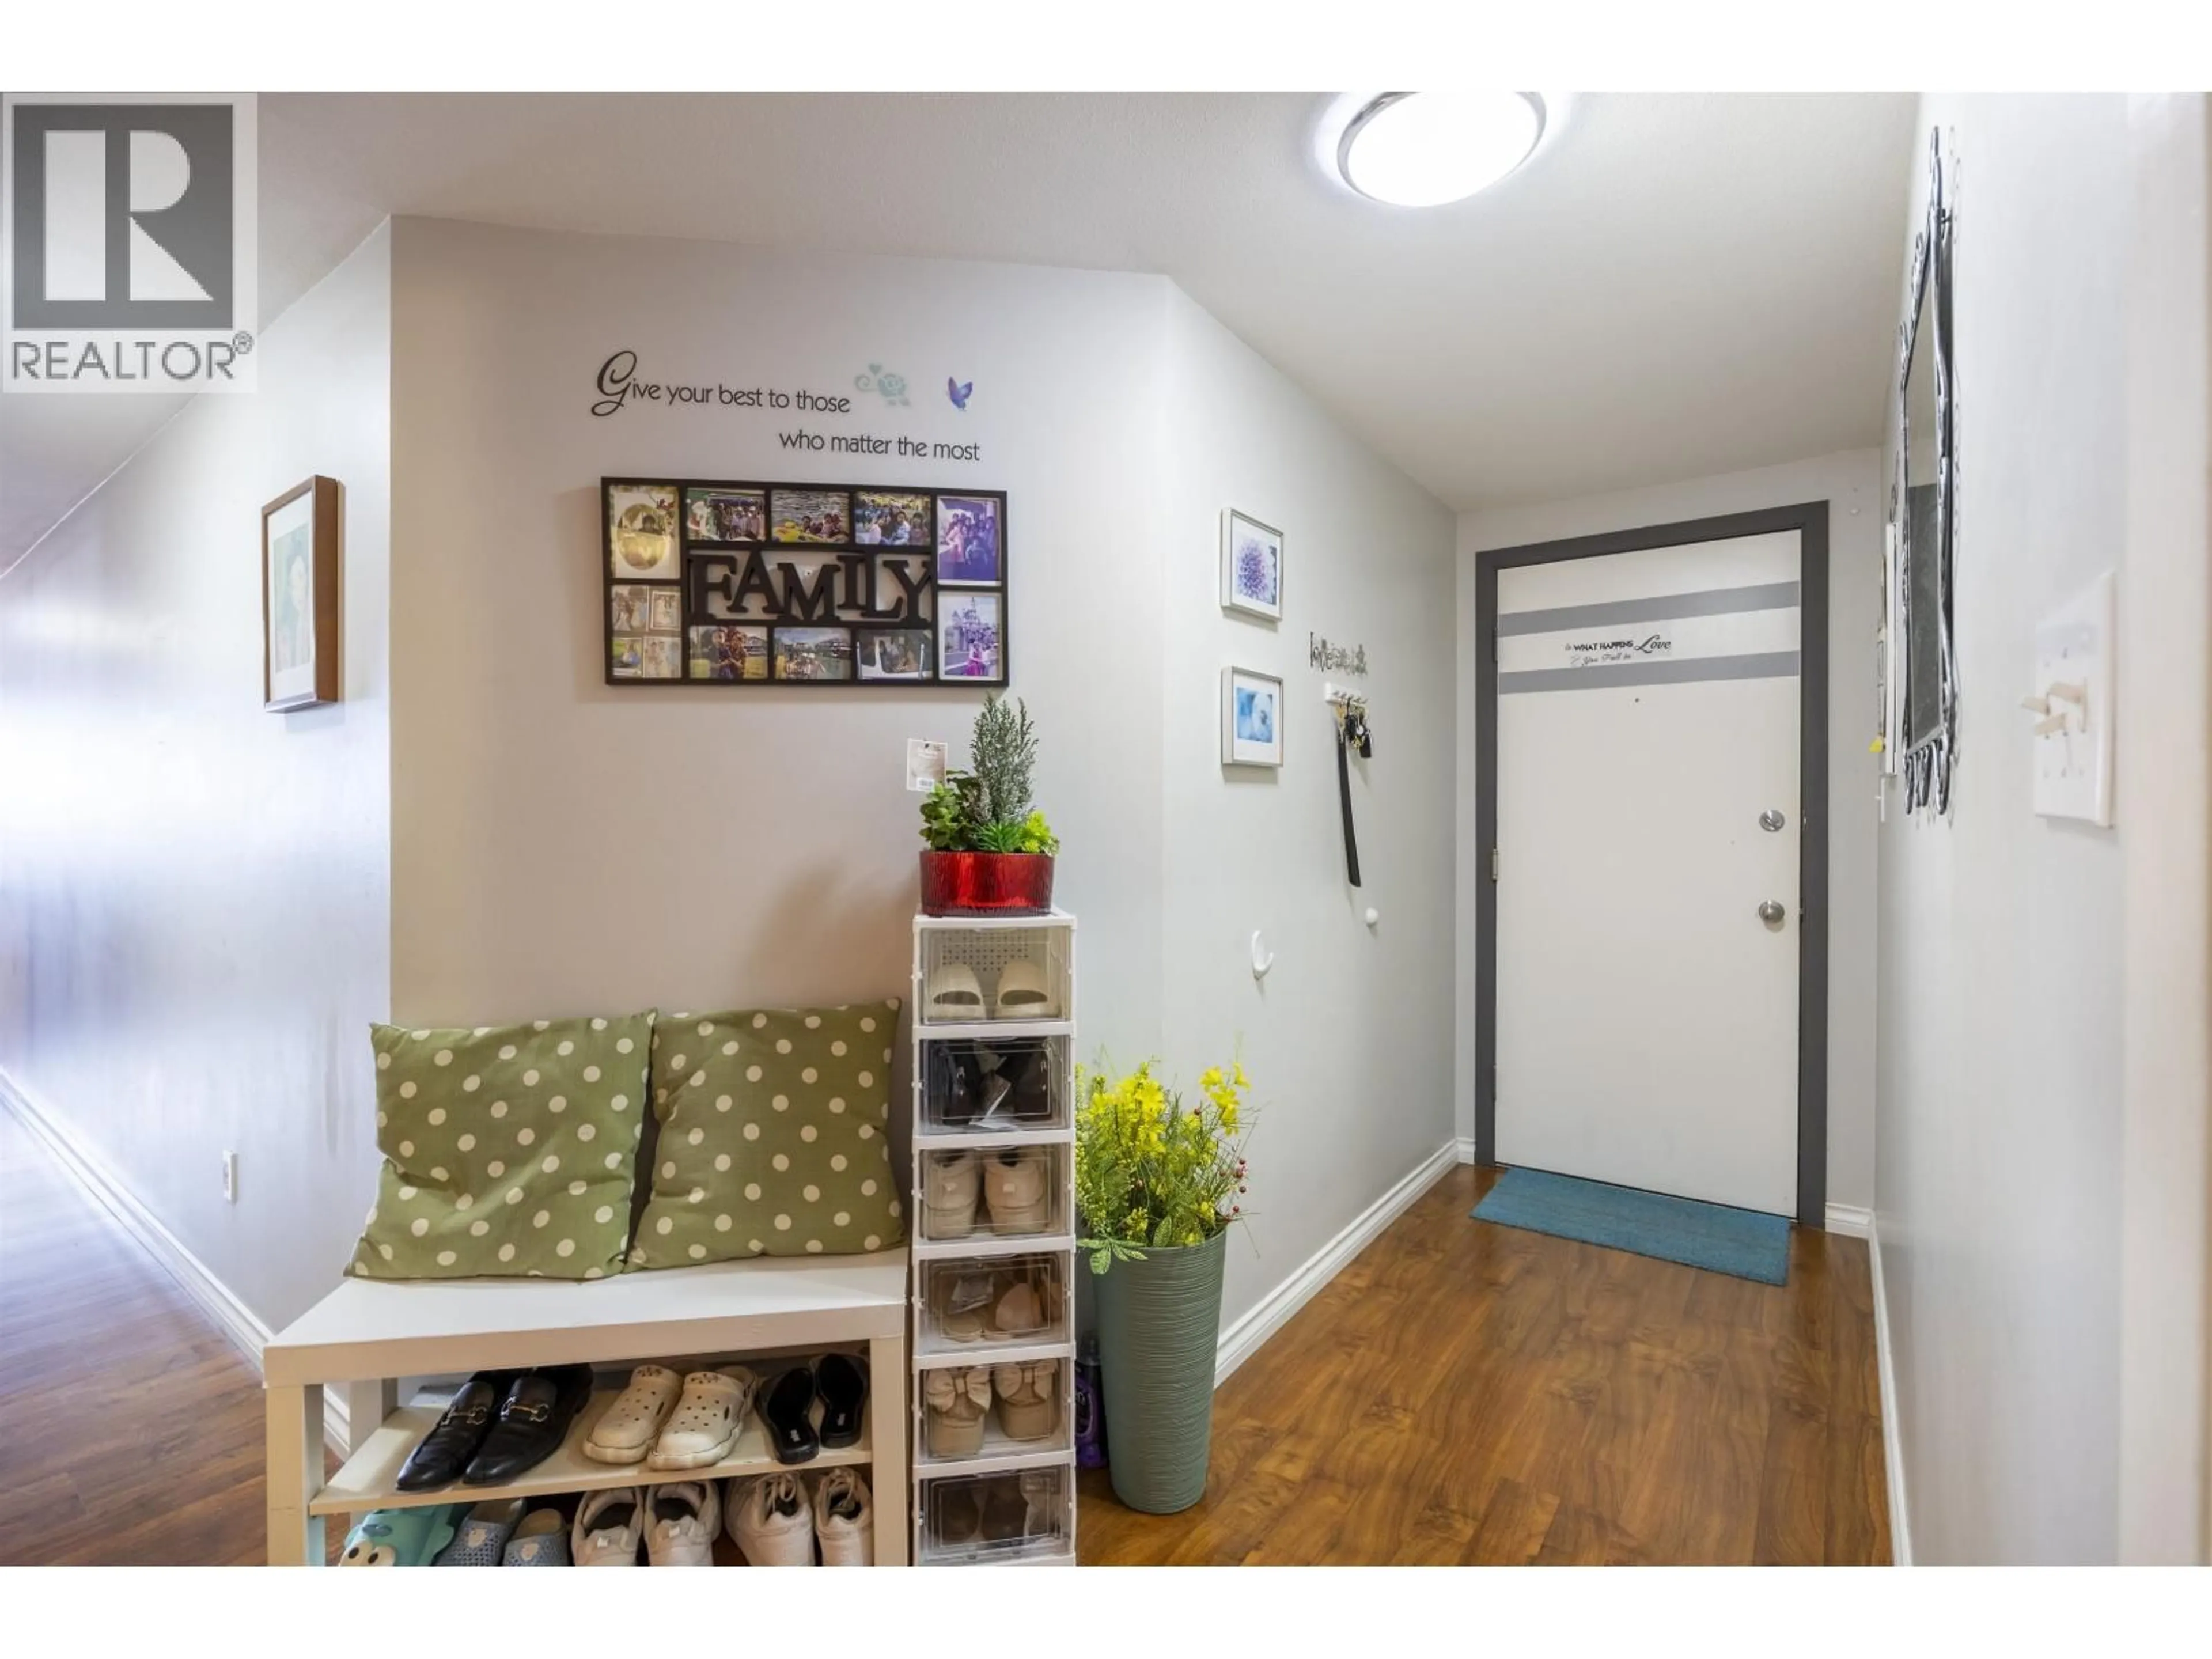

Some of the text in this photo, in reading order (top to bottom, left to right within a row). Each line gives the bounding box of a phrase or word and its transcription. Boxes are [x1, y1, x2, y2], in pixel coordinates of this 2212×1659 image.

[590, 350, 850, 417] Give your best to those
[779, 429, 980, 461] who matter the most
[688, 549, 934, 626] FAMILY
[1573, 642, 1598, 652] WHAT
[1599, 640, 1634, 650] HAPPENS
[1634, 634, 1671, 654] Love
